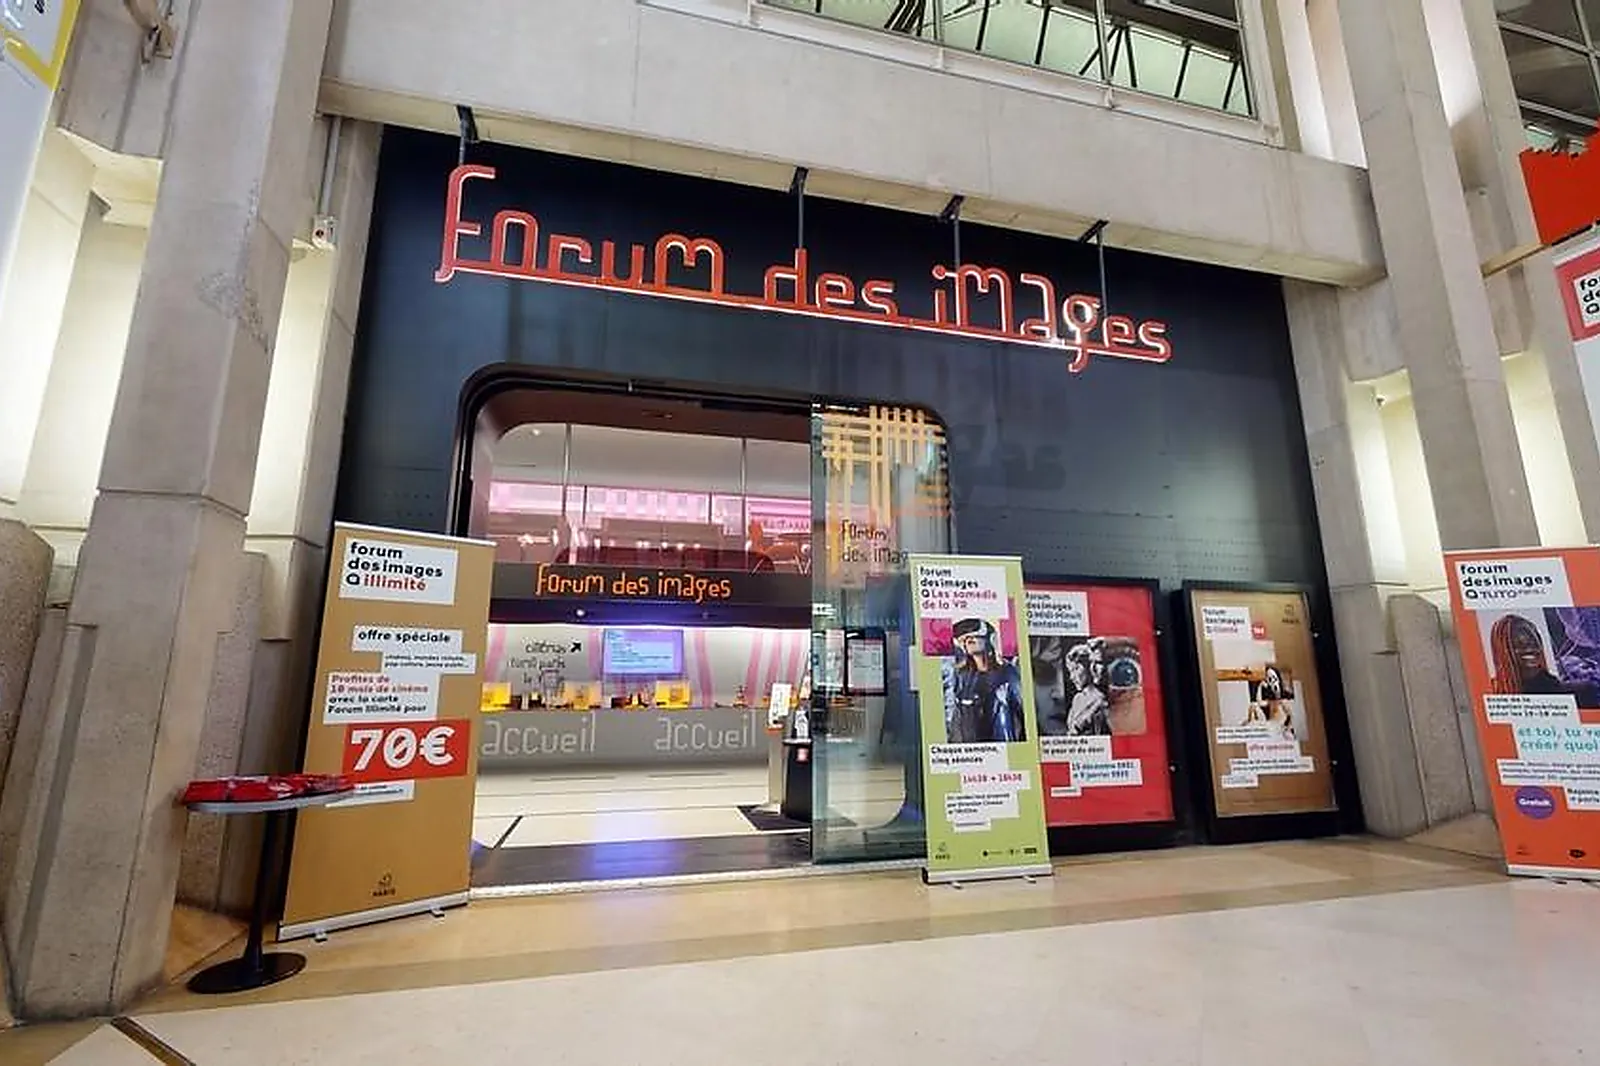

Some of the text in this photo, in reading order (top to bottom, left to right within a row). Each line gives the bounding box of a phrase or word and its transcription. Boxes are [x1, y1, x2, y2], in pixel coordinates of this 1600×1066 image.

[1580, 278, 1600, 290] fo
[764, 248, 899, 320] des
[932, 264, 1173, 374] images
[350, 541, 403, 559] forum
[920, 566, 952, 577] forum
[1460, 564, 1508, 575] forum
[363, 573, 426, 591] illimité
[612, 571, 649, 595] des
[657, 571, 732, 604] images
[921, 599, 936, 610] de
[357, 629, 451, 644] offre spéciale
[376, 674, 390, 684] de
[375, 684, 389, 693] de
[328, 694, 399, 704] avec la carte
[327, 705, 363, 714] Forum
[403, 704, 427, 714] pour
[481, 710, 596, 755] accueil
[654, 708, 756, 751] accueil
[351, 726, 456, 771] 70€
